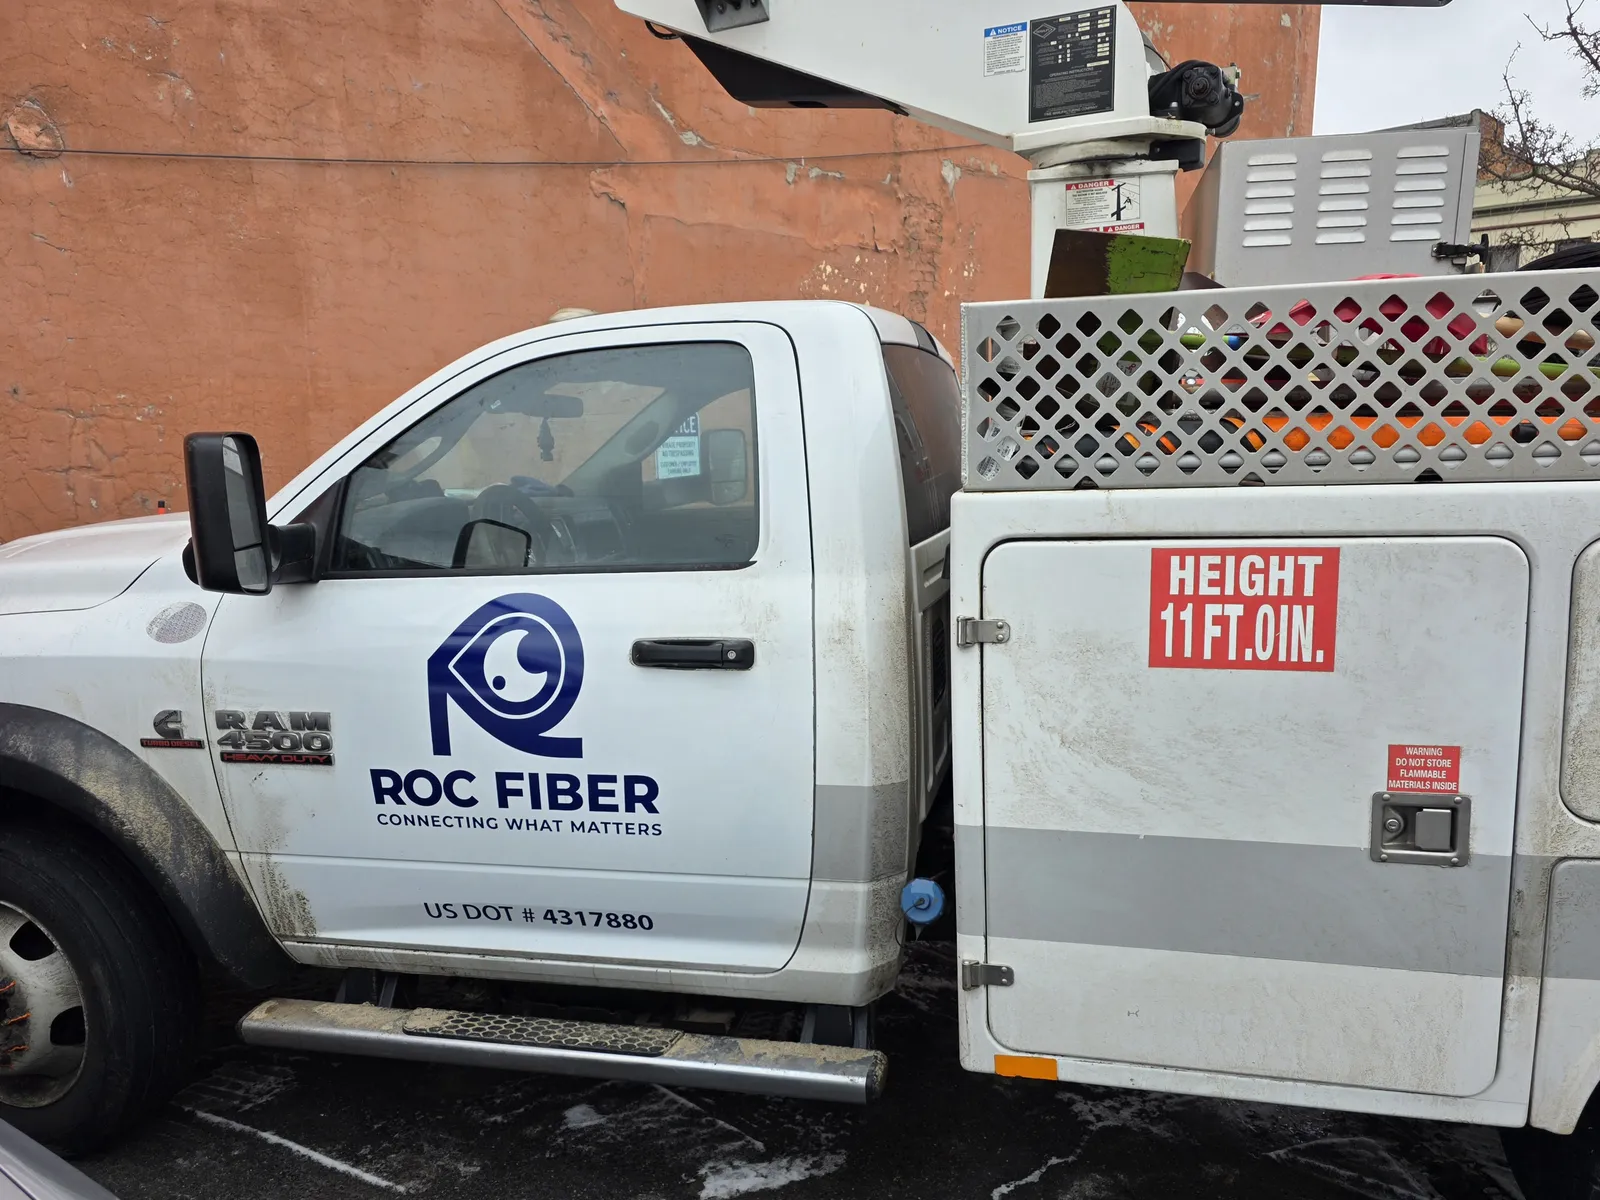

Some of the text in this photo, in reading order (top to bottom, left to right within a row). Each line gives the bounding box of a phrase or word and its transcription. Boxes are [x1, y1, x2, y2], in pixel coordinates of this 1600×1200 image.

[997, 24, 1022, 34] NOTICE
[1077, 180, 1109, 189] DANGER
[1114, 223, 1140, 231] DANGER
[1169, 554, 1323, 597] HEIGHT
[215, 709, 332, 731] RAM
[217, 731, 333, 750] 4500
[1405, 747, 1443, 756] WARNING
[223, 753, 329, 763] HEAVY DUTY
[1395, 757, 1452, 768] DO NOT STORE
[1400, 769, 1447, 779] FLAMMABLE
[1388, 779, 1457, 791] MATERIALS INSIDE
[370, 768, 660, 814] ROC FIBER
[377, 813, 663, 836] CONNECTING WHAT MATTERS
[424, 902, 654, 931] US DOT # 4317880
